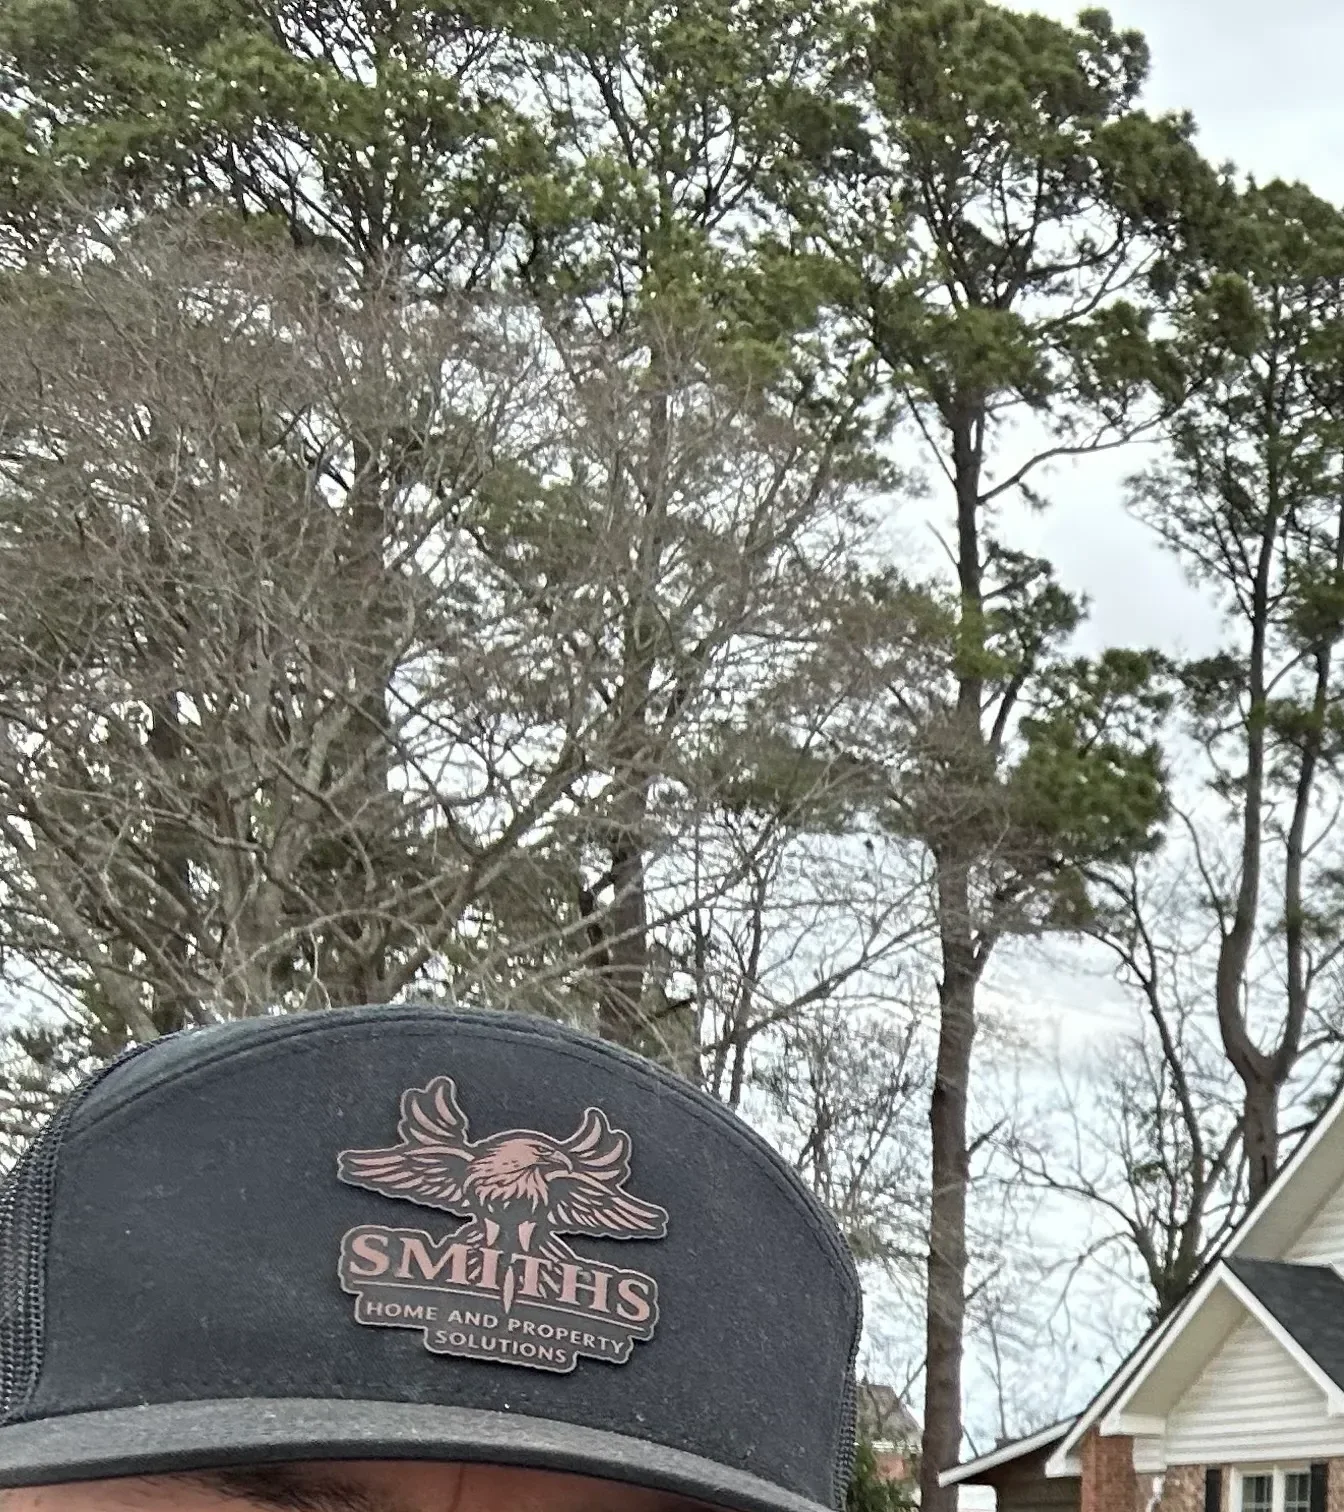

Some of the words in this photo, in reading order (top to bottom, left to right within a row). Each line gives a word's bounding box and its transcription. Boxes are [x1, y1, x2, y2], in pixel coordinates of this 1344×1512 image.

[350, 1233, 650, 1322] SMITHS
[366, 1302, 438, 1321] HOME
[448, 1309, 498, 1329] AND
[507, 1317, 626, 1355] PROPERTY
[434, 1329, 567, 1364] SOLUTIONS
